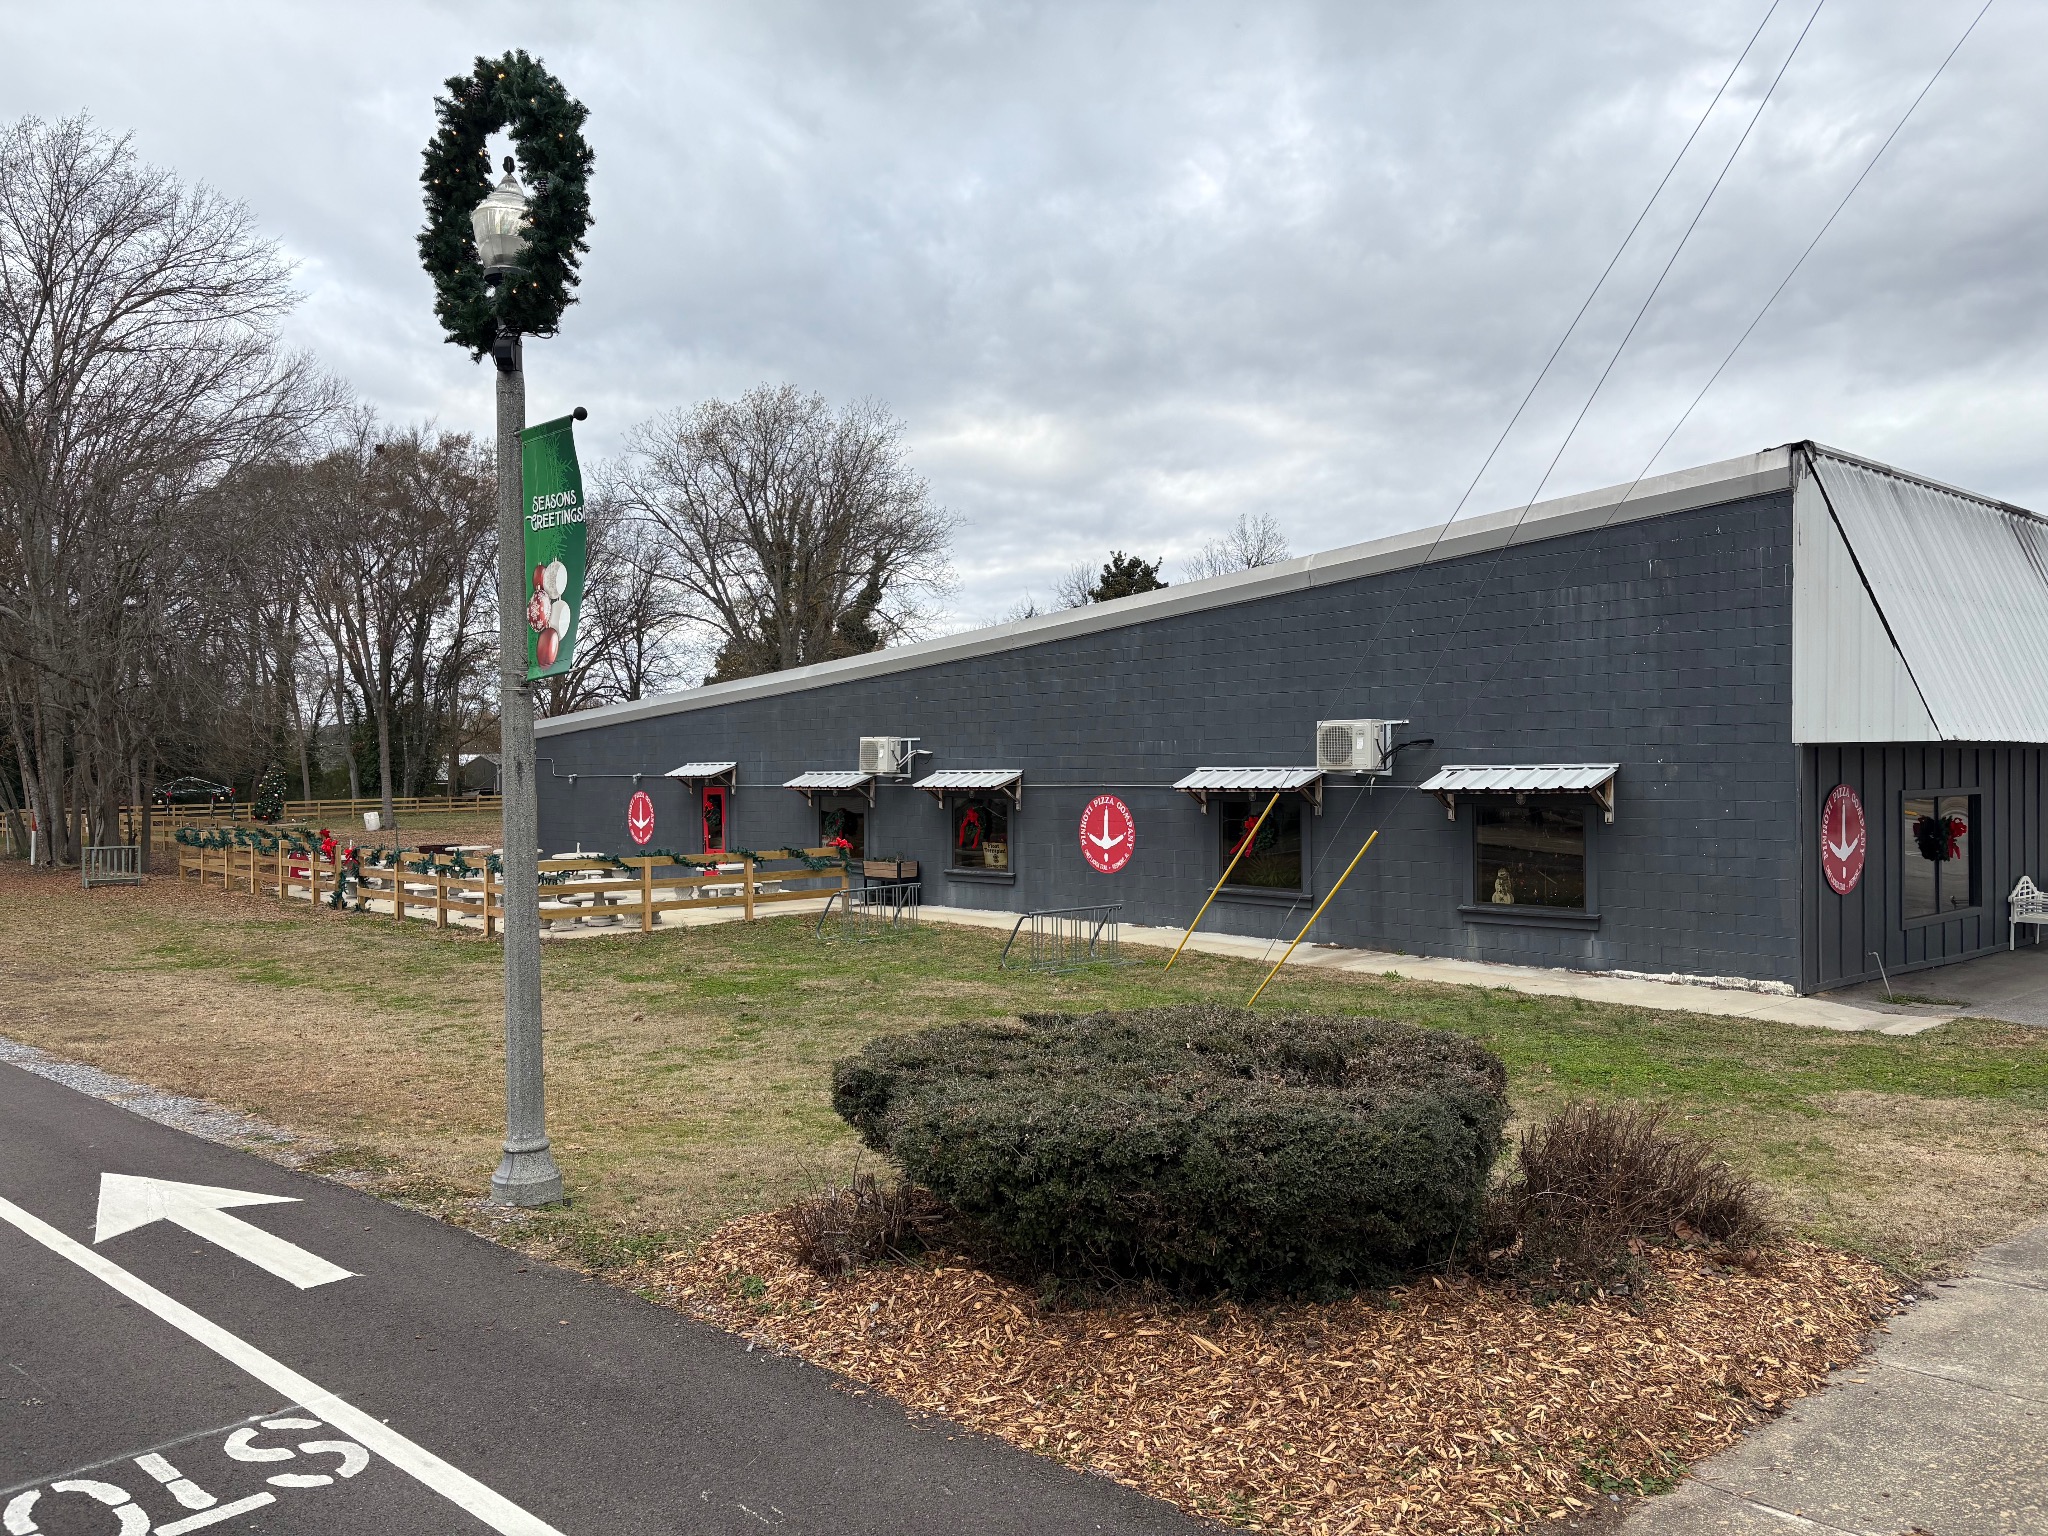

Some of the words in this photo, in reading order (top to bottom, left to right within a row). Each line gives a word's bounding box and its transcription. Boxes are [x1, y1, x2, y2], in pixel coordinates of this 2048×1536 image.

[532, 489, 577, 514] SEASONS
[1080, 805, 1093, 846] PINHOTI
[1093, 796, 1114, 807] PIZZA
[1116, 801, 1134, 850] COMPANY
[1833, 787, 1850, 803] PIZZA
[1851, 793, 1866, 856] COMPANY
